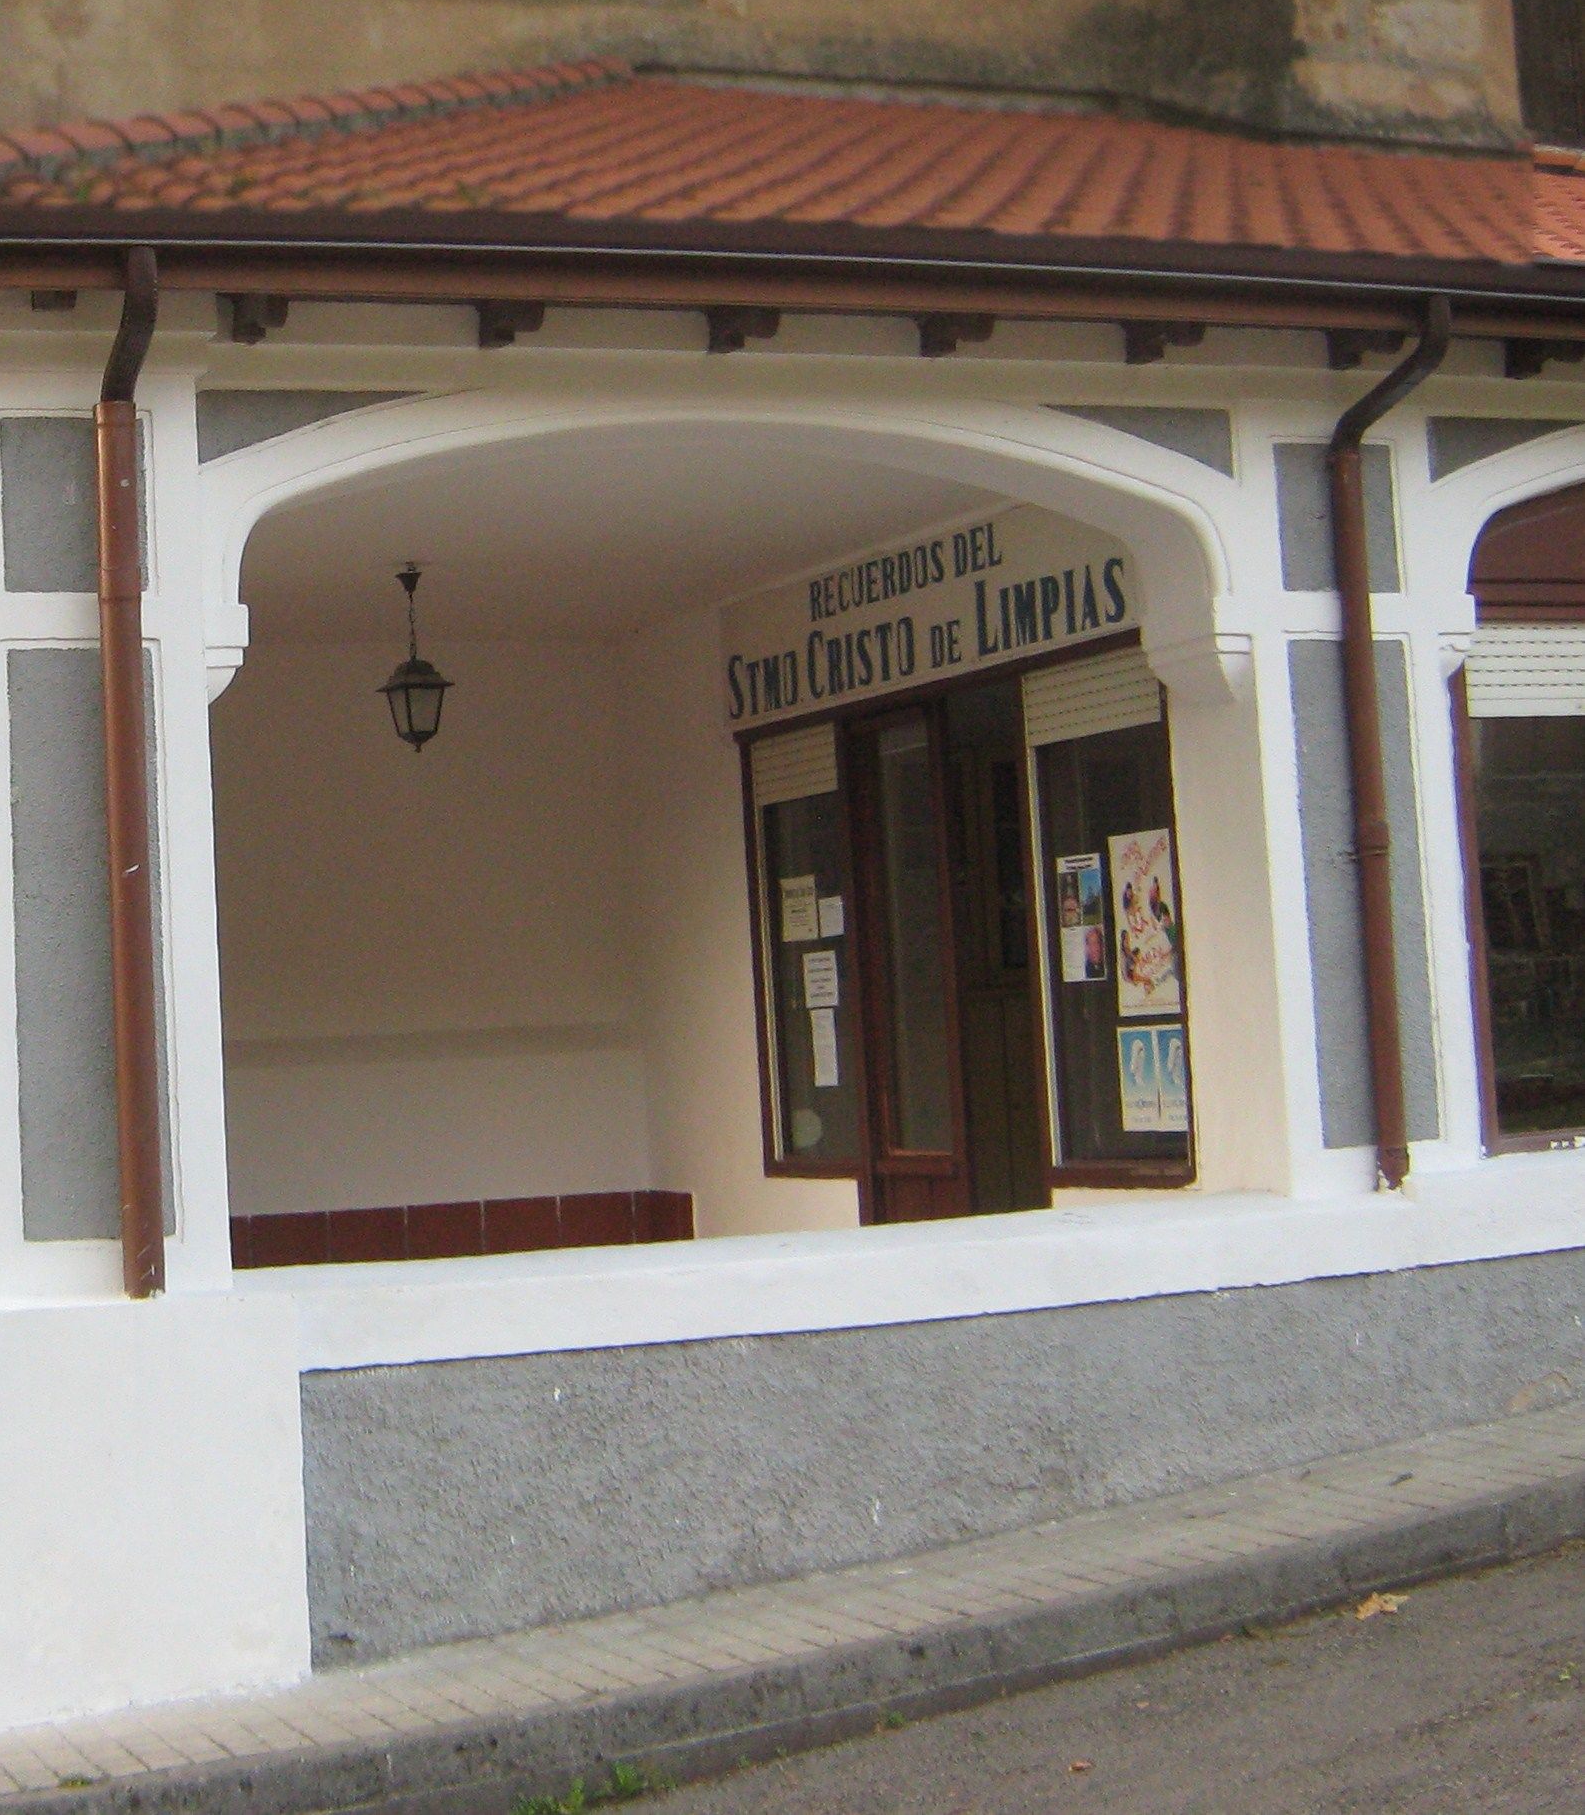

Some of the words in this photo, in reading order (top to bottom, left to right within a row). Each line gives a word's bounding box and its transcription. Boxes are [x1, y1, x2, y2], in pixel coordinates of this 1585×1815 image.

[806, 616, 915, 700] CRISTO
[930, 619, 962, 669] DE
[975, 557, 1126, 657] LIMPIAS
[809, 539, 945, 622] RECUERDOS
[952, 522, 1002, 578] DEL
